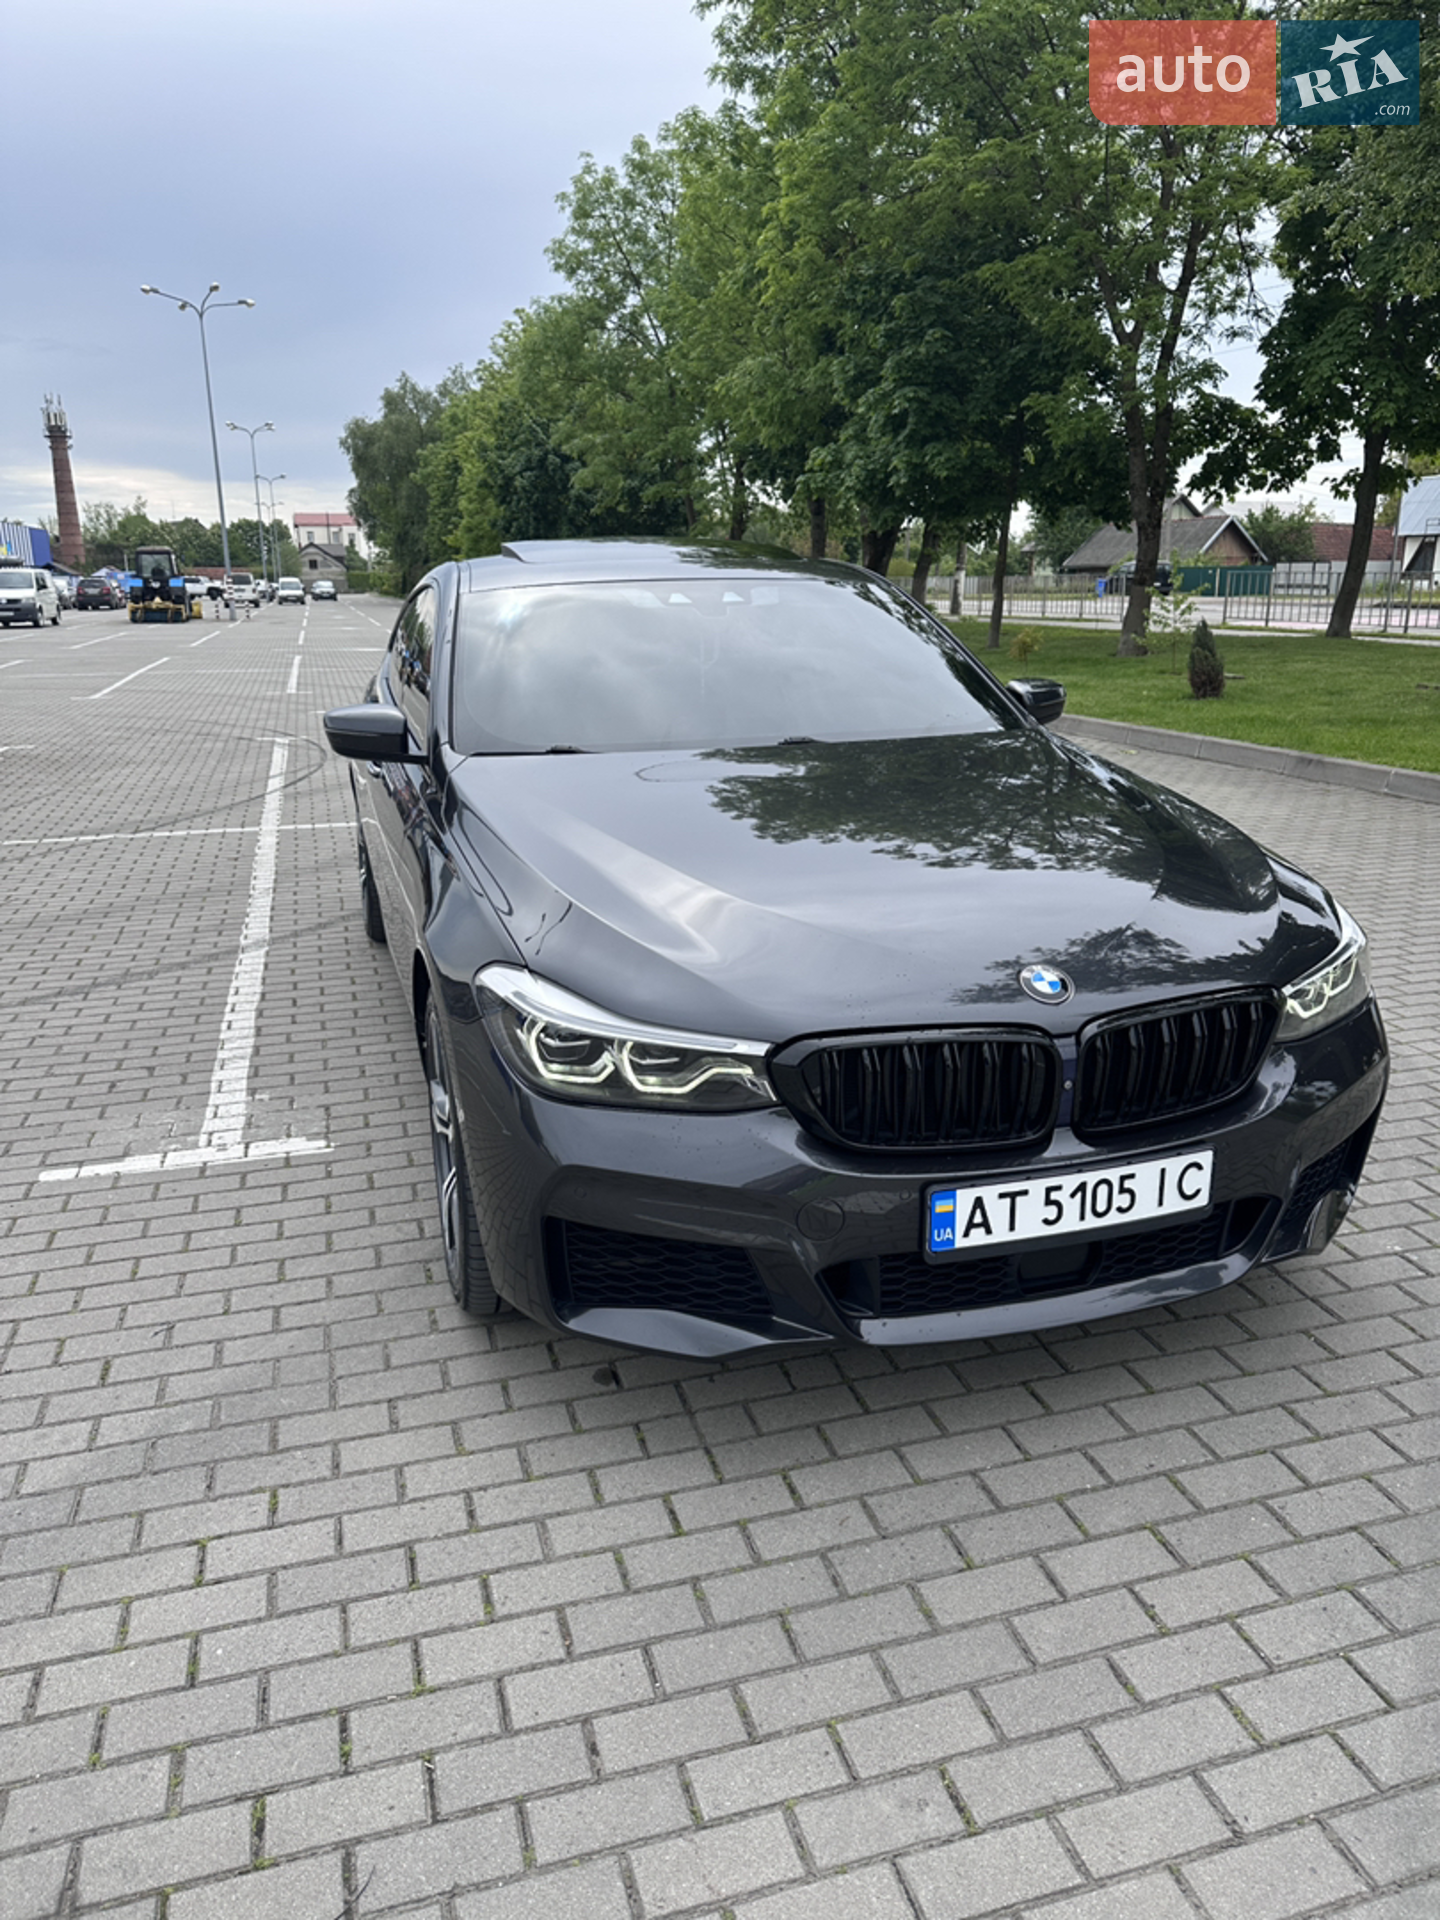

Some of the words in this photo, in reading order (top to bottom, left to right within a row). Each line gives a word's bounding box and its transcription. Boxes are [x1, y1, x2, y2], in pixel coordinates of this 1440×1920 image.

[962, 1189, 1029, 1238] AT
[1041, 1173, 1136, 1226] 5105
[1157, 1161, 1204, 1208] IC
[934, 1227, 954, 1242] UA
